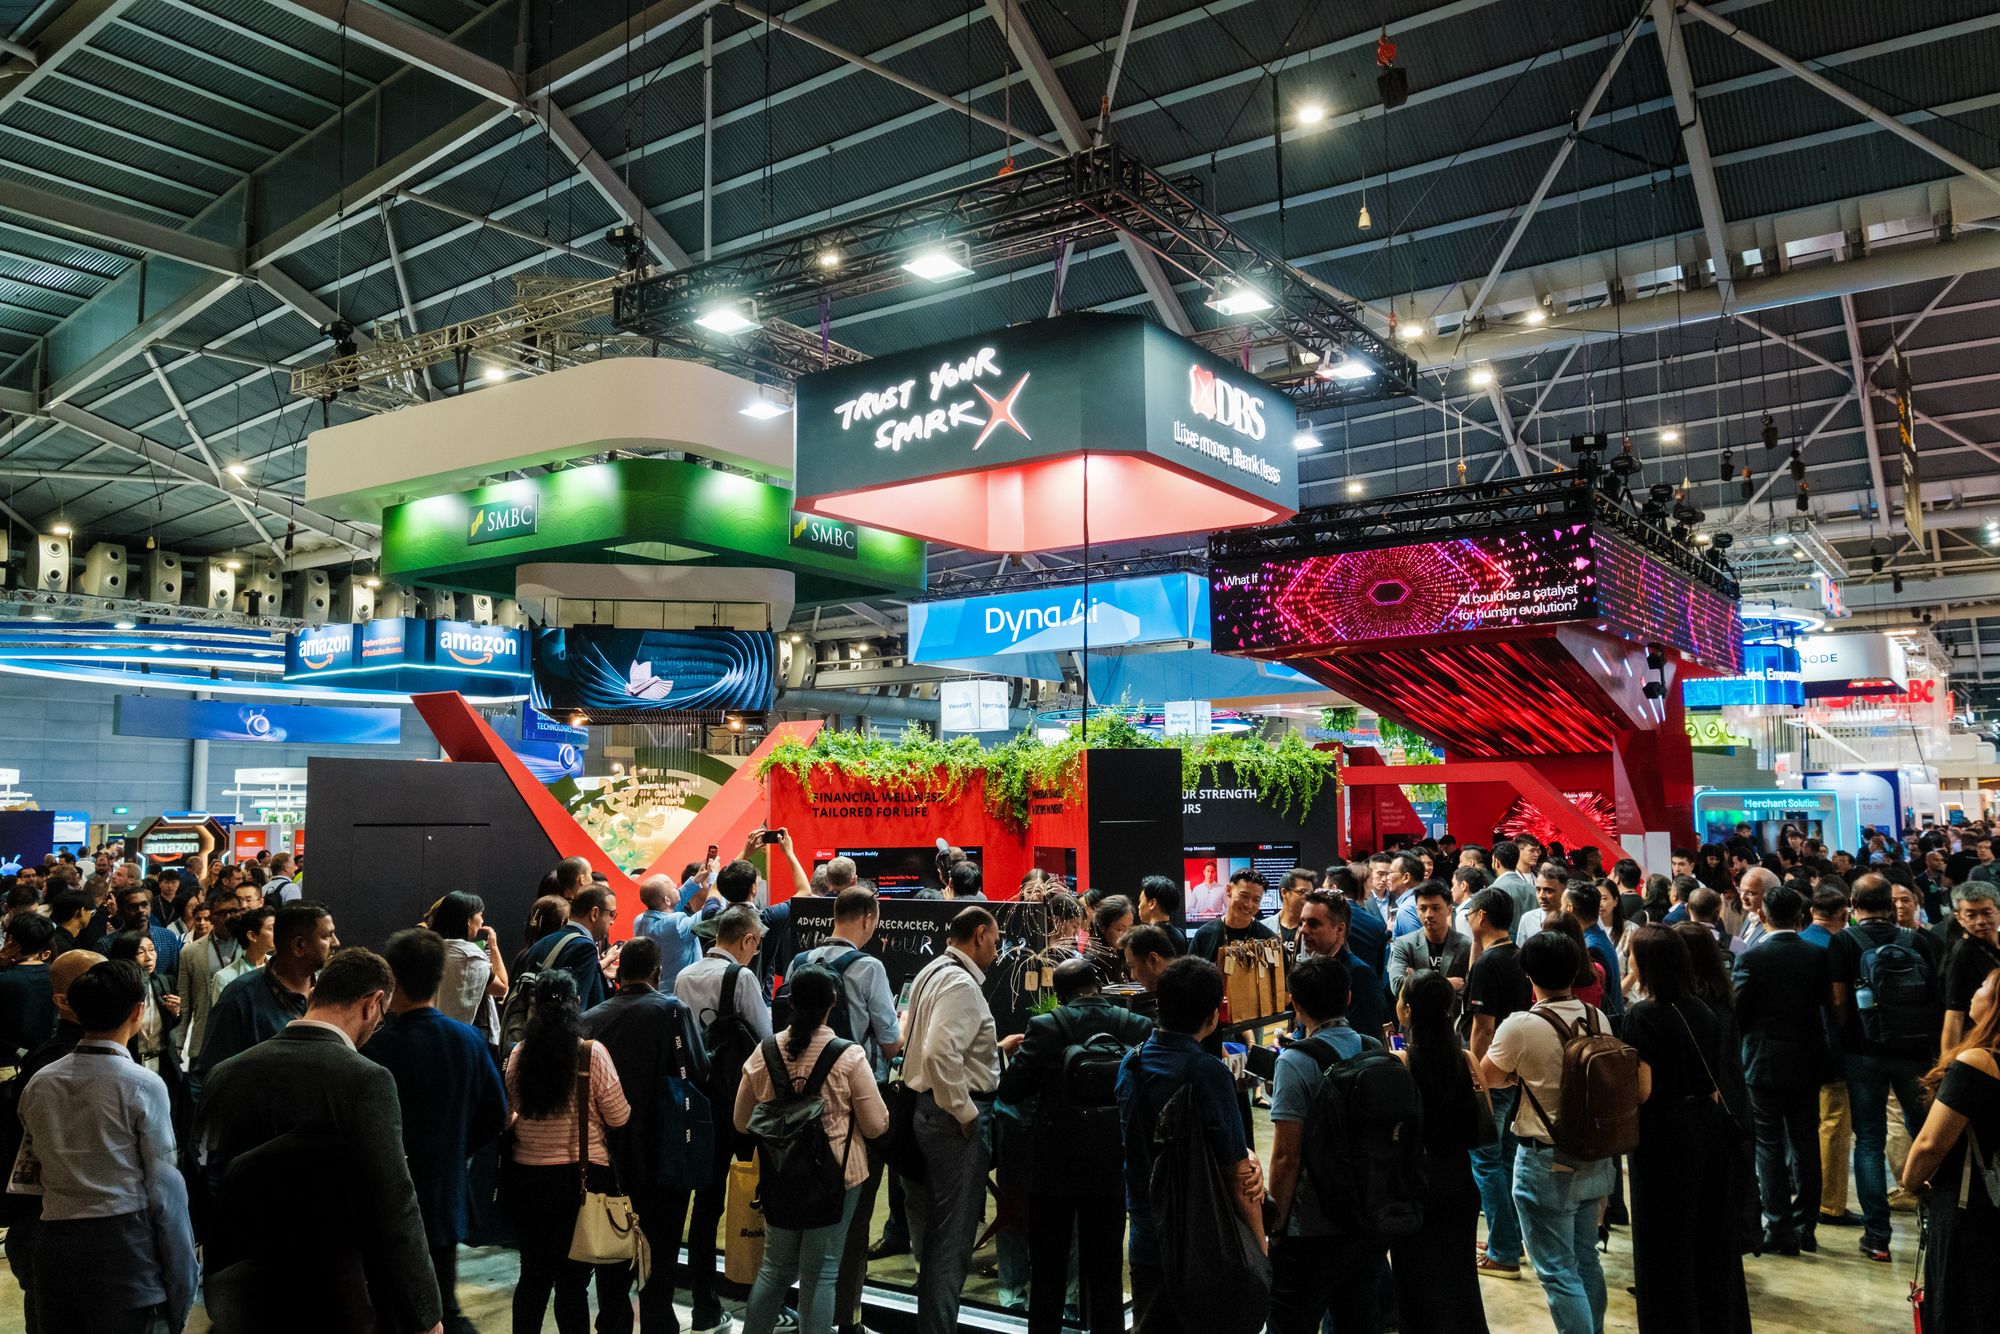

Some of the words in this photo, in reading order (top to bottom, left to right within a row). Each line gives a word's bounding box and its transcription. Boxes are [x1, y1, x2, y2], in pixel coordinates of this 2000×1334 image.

[834, 379, 916, 430] TRUST
[930, 347, 1001, 399] YOUR
[1215, 378, 1266, 441] DBS
[874, 401, 987, 452] SPARK
[1173, 420, 1199, 448] Live
[1233, 447, 1260, 475] Bank
[1260, 458, 1281, 483] less
[487, 504, 532, 532] SMBC
[811, 521, 855, 550] SMBC
[1223, 573, 1250, 588] What
[1251, 572, 1259, 585] If
[1458, 593, 1472, 606] AI
[1472, 589, 1504, 605] could
[1505, 588, 1521, 603] be
[1523, 591, 1531, 600] a
[1533, 584, 1579, 600] catalyst
[1458, 608, 1475, 621] for
[1476, 604, 1517, 619] human
[1519, 599, 1579, 617] evolution?
[299, 634, 350, 657] amazon
[440, 630, 516, 656] amazon
[813, 792, 879, 803] FINANCIAL
[1199, 789, 1257, 799] STRENGTH
[1744, 798, 1787, 808] Merchant
[1787, 798, 1820, 808] Solutions
[812, 807, 873, 817] TAILORED
[876, 807, 900, 817] FOR
[904, 807, 928, 817] LIFE
[145, 842, 199, 853] amazon
[876, 919, 939, 932] RECRACKER,
